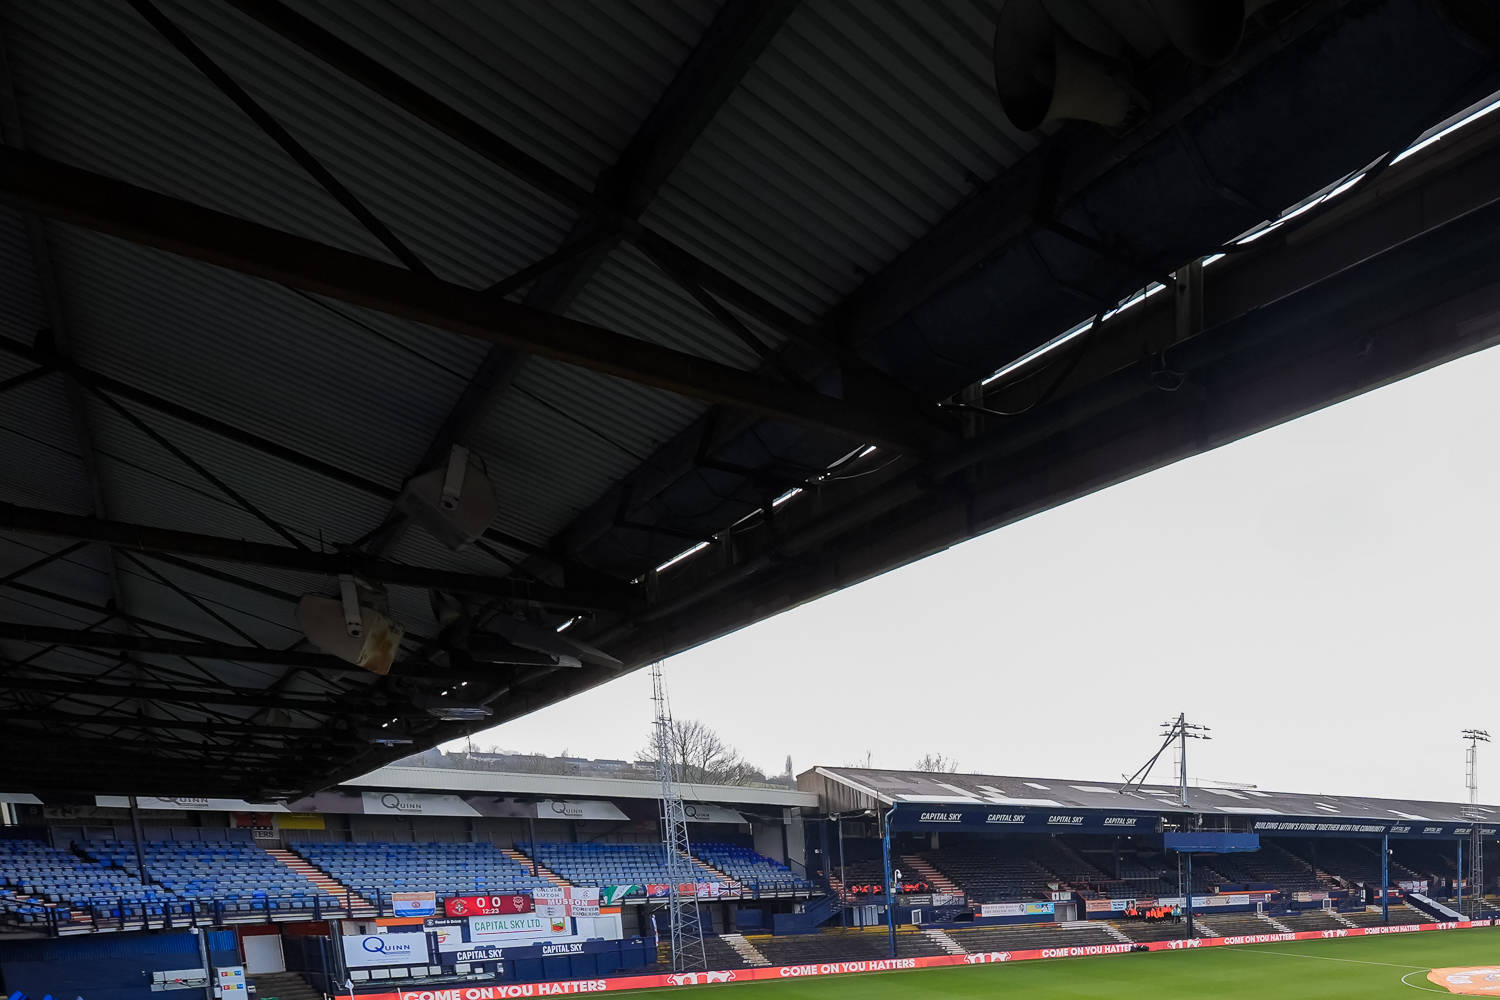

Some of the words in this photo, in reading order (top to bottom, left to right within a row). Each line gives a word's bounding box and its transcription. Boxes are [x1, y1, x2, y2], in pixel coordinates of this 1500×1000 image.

[381, 793, 422, 810] QUINN
[551, 801, 583, 815] QUINN
[920, 812, 947, 820] CAPITAL
[948, 813, 962, 821] SKY
[988, 814, 1012, 822] CAPITAL
[1012, 814, 1026, 822] SKY
[476, 897, 485, 908] 0
[492, 897, 501, 907] 0
[548, 898, 588, 906] MUSSON
[474, 920, 508, 931] CAPITAL
[510, 920, 526, 929] SKY
[527, 918, 543, 928] LTD.
[1224, 936, 1244, 944] COME
[1270, 933, 1296, 942] HATTERS
[363, 937, 410, 954] QUINN
[542, 945, 570, 954] CAPITAL
[570, 944, 583, 952] SKY
[457, 950, 488, 960] CAPITAL
[489, 949, 503, 958] SKY
[1042, 949, 1068, 958] COME
[1070, 948, 1084, 956] ON
[1085, 946, 1103, 954] YOU
[780, 965, 817, 977] COME
[821, 964, 839, 974] ON
[842, 962, 865, 972] YOU
[869, 959, 915, 970] HATTERS
[466, 987, 494, 1000] ON
[497, 985, 533, 998] YOU
[539, 980, 606, 996] HATTERS
